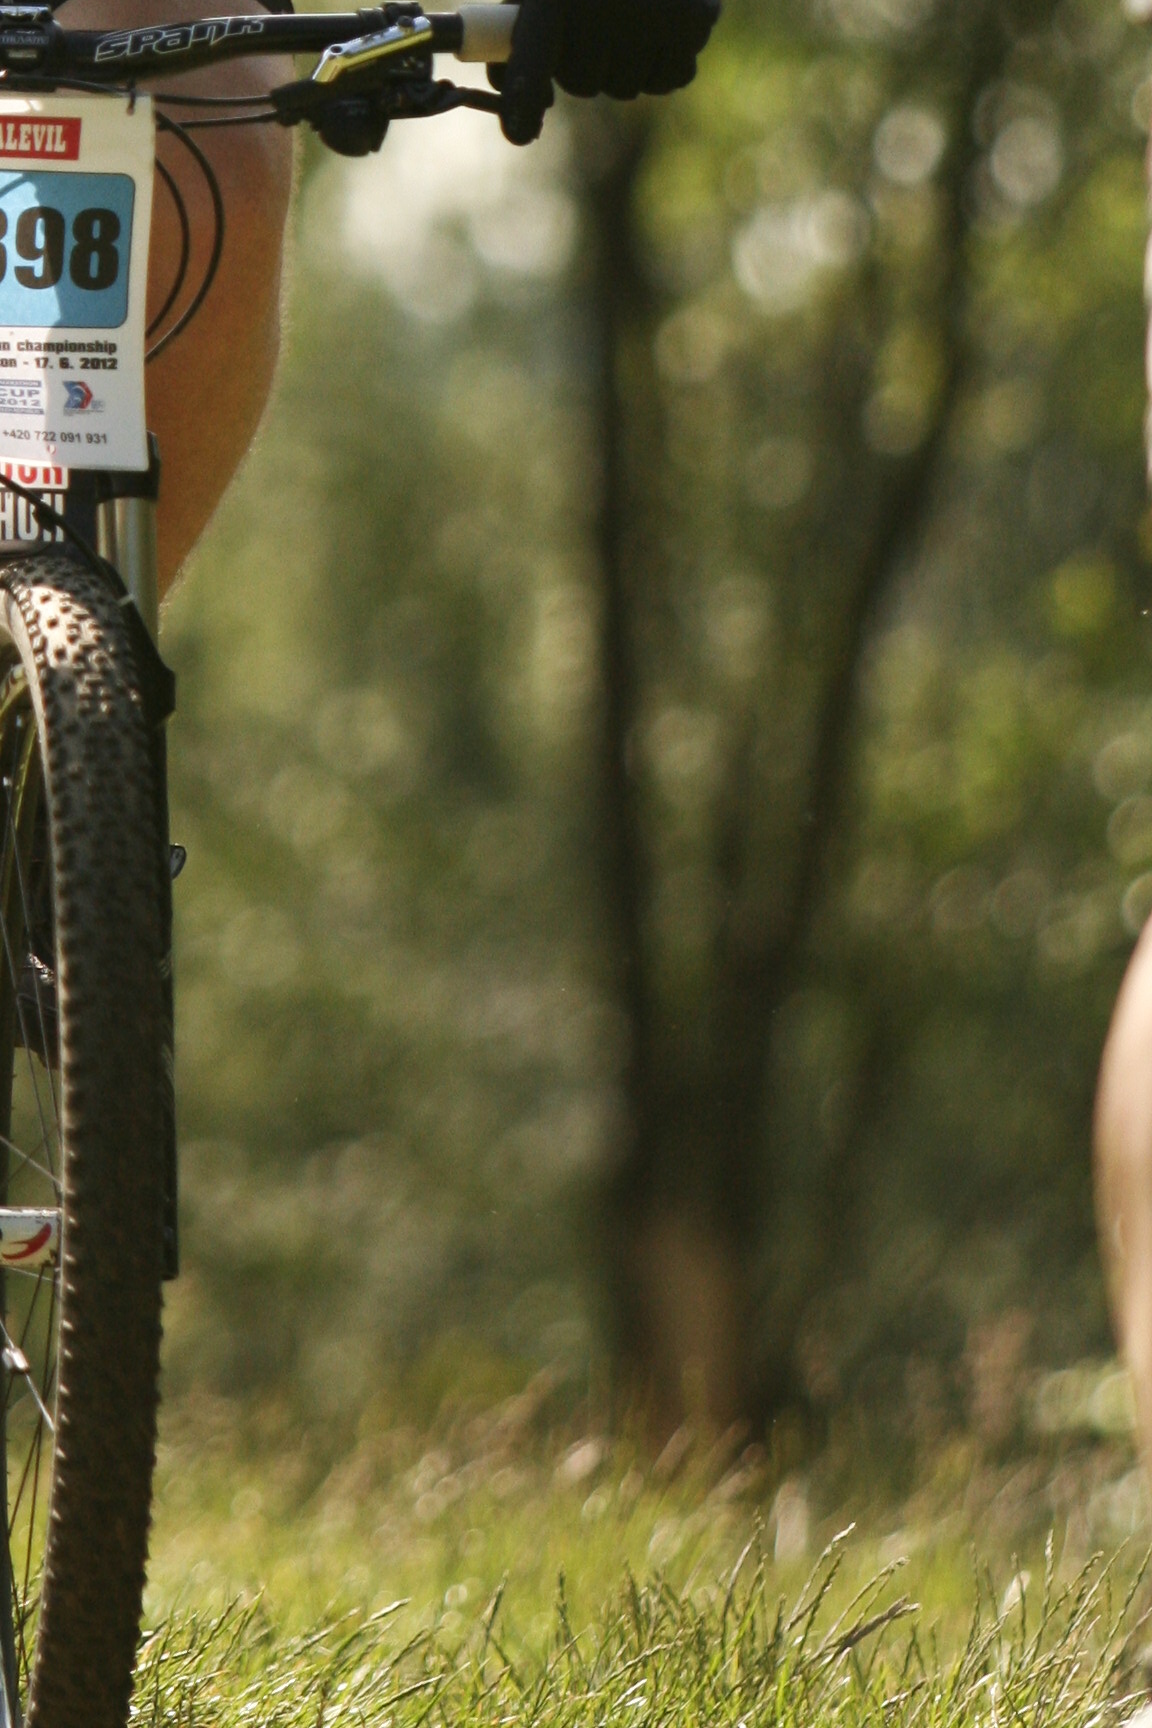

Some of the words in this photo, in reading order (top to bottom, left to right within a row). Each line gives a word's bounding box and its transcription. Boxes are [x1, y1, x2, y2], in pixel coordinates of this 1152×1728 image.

[17, 339, 118, 355] championship
[35, 357, 54, 370] 17.
[59, 357, 75, 370] 6.
[80, 357, 118, 370] 2012
[2, 429, 31, 441] +420
[35, 430, 57, 442] 722
[60, 431, 82, 443] 091
[85, 432, 108, 444] 931
